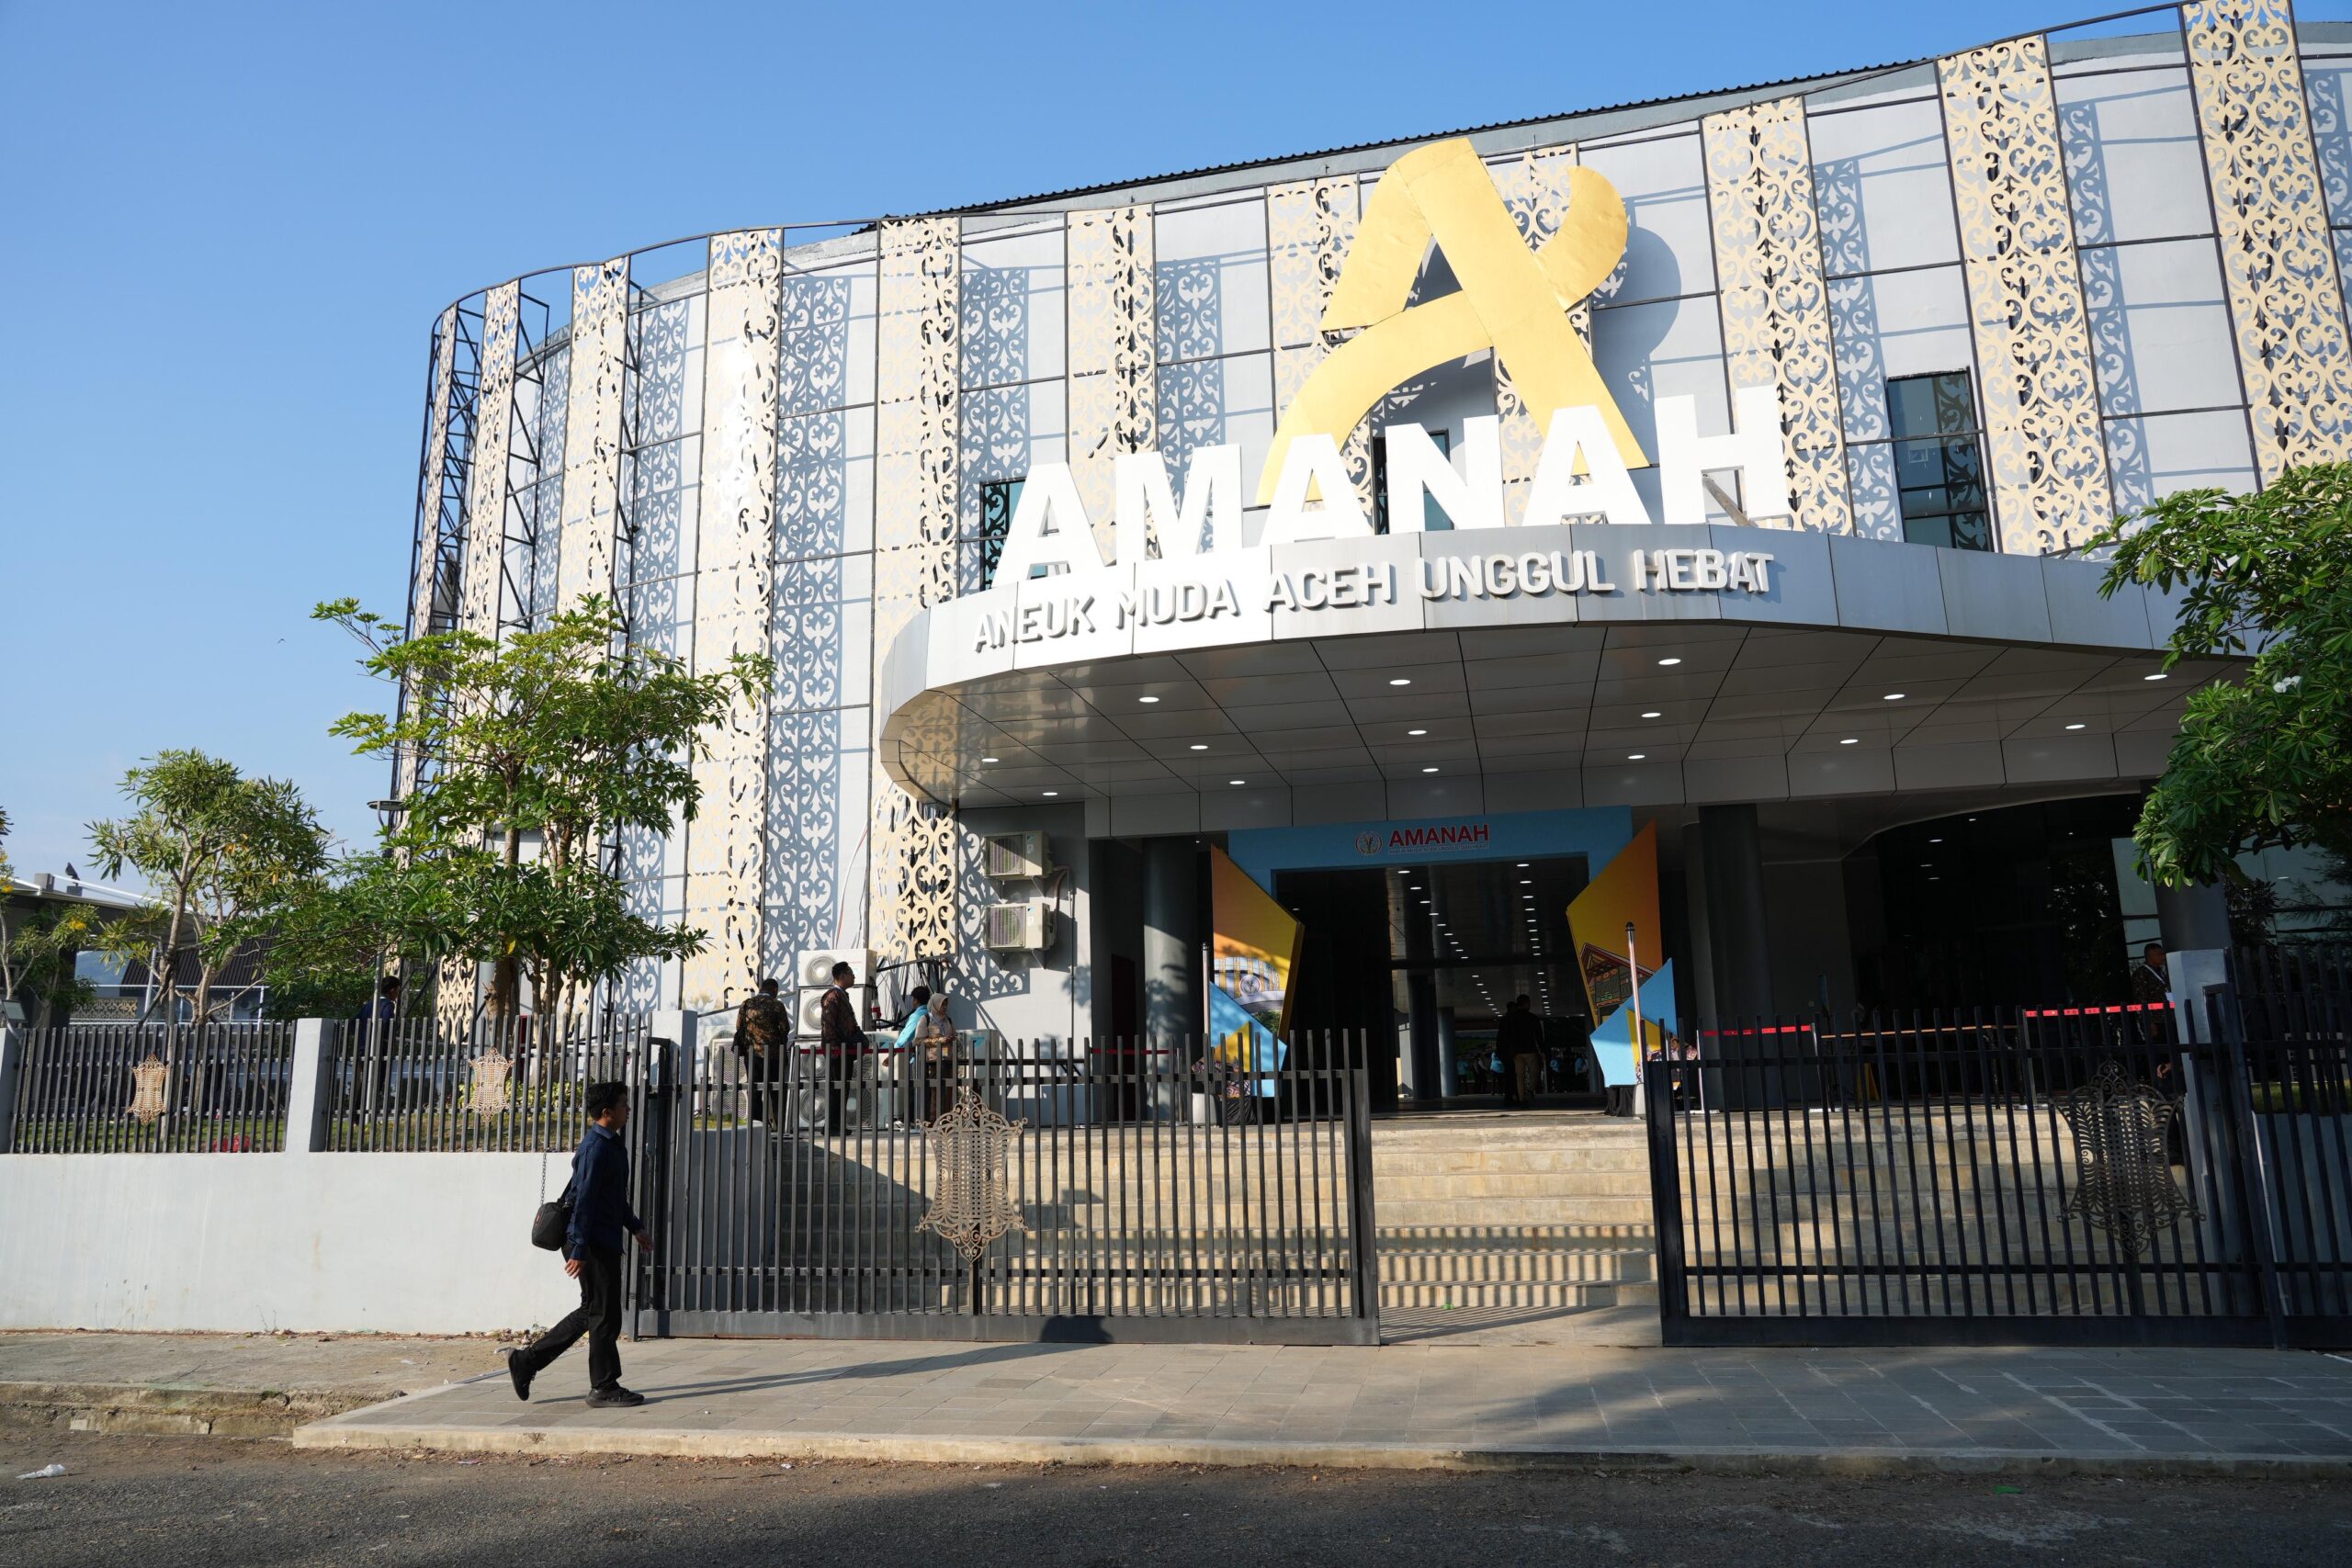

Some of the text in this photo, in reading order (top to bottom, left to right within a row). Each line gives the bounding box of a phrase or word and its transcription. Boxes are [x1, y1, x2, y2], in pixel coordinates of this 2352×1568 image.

[992, 386, 1793, 588] AMANAH
[972, 549, 1775, 653] ANEUK MUDA ACEH UNGGUL HEBAT
[1388, 824, 1489, 847] AMANAH
